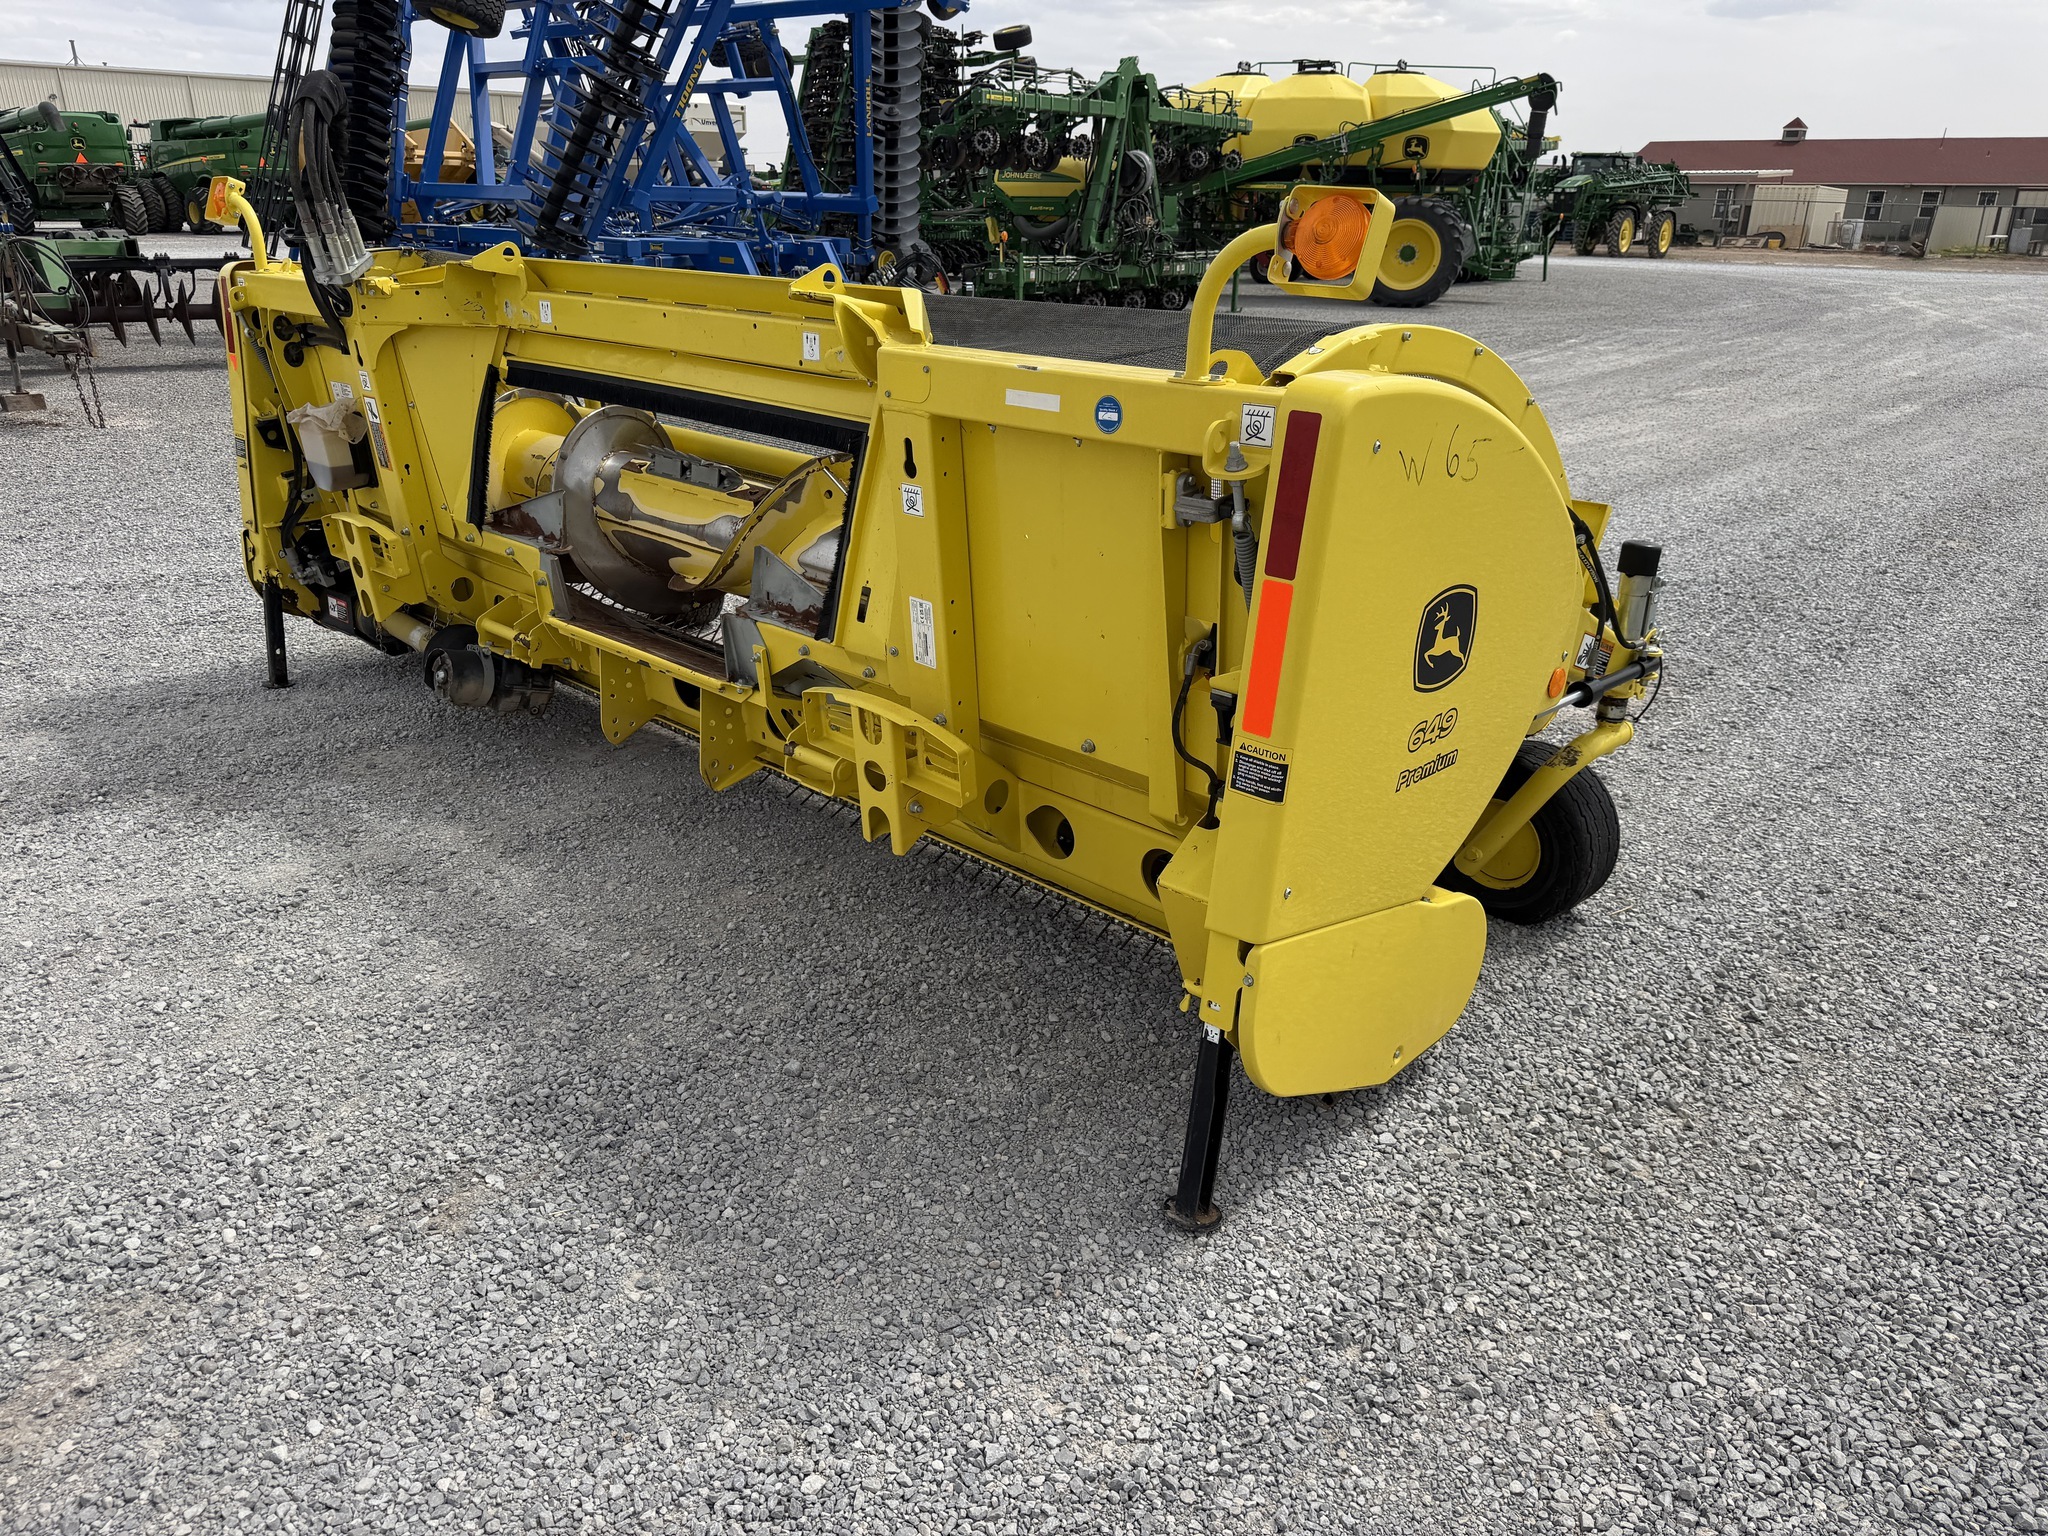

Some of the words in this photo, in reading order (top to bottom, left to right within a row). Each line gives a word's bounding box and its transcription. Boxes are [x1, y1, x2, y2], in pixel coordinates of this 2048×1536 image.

[673, 48, 707, 118] LANDOLL
[1399, 437, 1433, 487] W
[1247, 745, 1286, 761] CAUTION
[1407, 707, 1458, 753] 649
[1395, 749, 1458, 793] Premium
